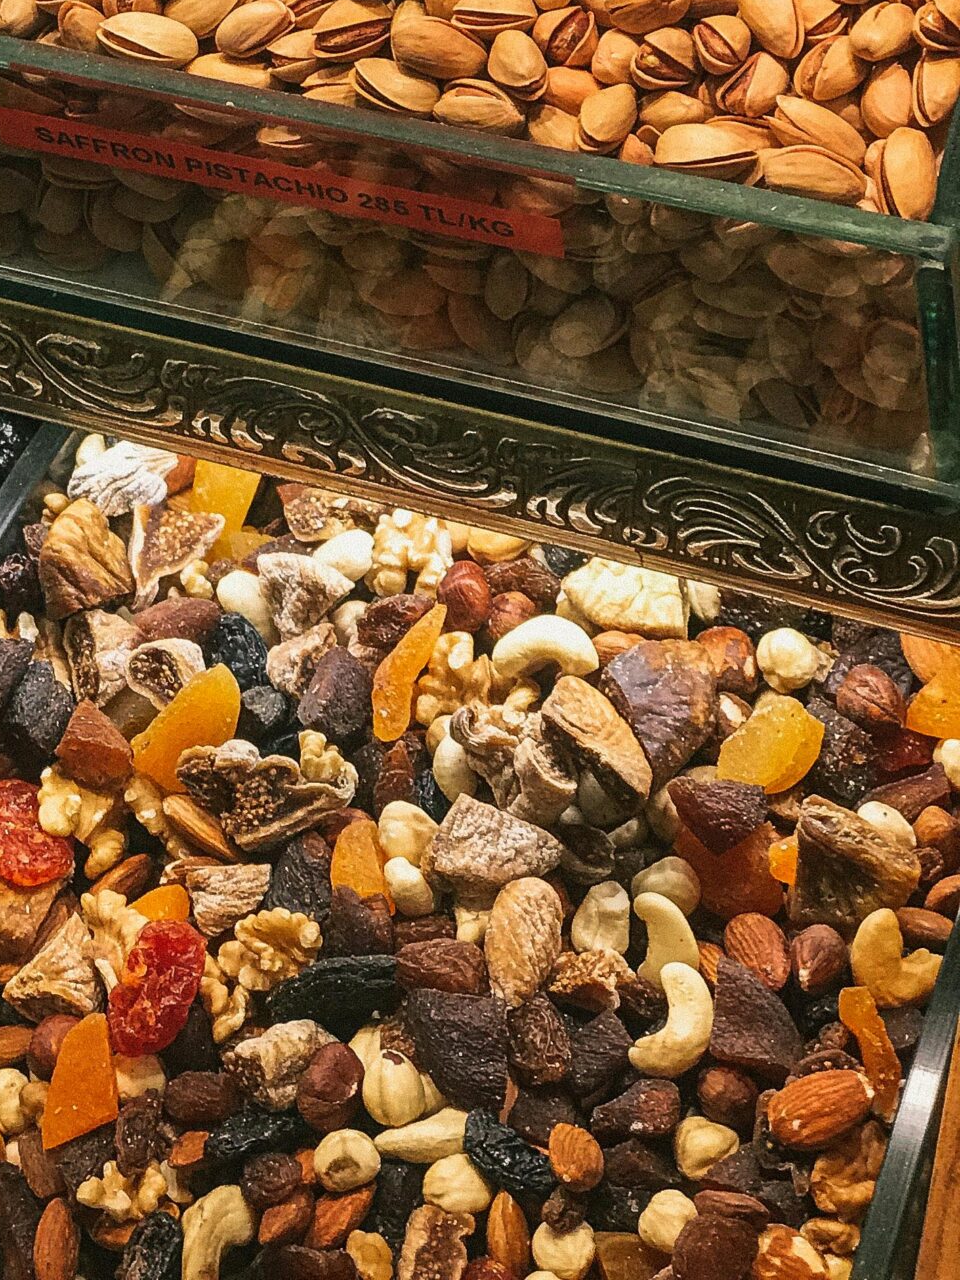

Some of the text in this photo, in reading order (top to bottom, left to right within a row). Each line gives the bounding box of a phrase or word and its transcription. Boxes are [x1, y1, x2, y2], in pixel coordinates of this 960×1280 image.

[35, 126, 515, 238] SAFFRON PISTACHIO 285 TL/KG
